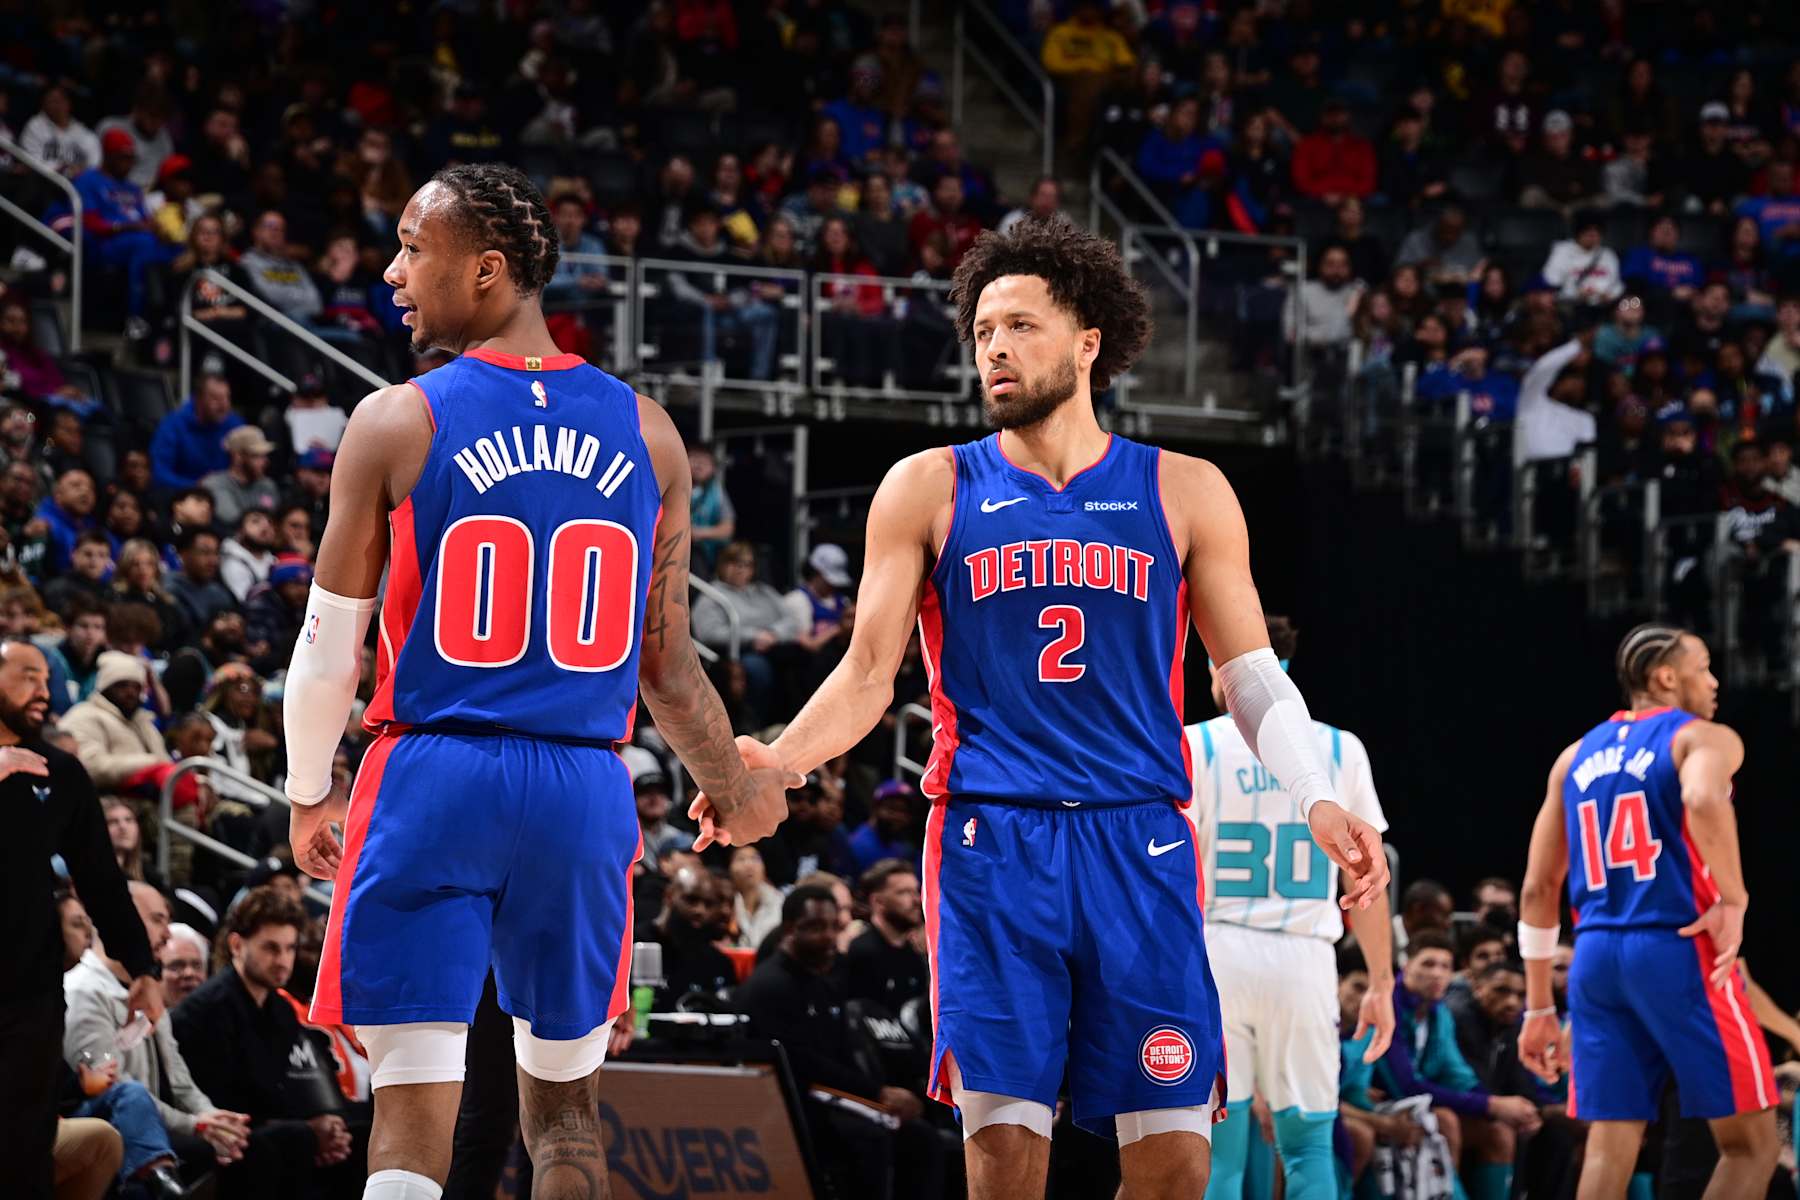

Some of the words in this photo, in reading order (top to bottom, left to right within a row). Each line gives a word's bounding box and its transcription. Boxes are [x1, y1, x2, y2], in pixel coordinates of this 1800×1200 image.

[453, 424, 600, 495] HOLLAND
[595, 450, 635, 499] II
[1084, 500, 1138, 511] StockX
[433, 514, 639, 673] 00
[964, 538, 1155, 602] DETROIT
[1038, 604, 1087, 683] 2
[1215, 822, 1330, 900] 30
[1577, 789, 1663, 892] 14
[1149, 1044, 1184, 1056] DETROIT
[1150, 1055, 1185, 1065] PISTONS
